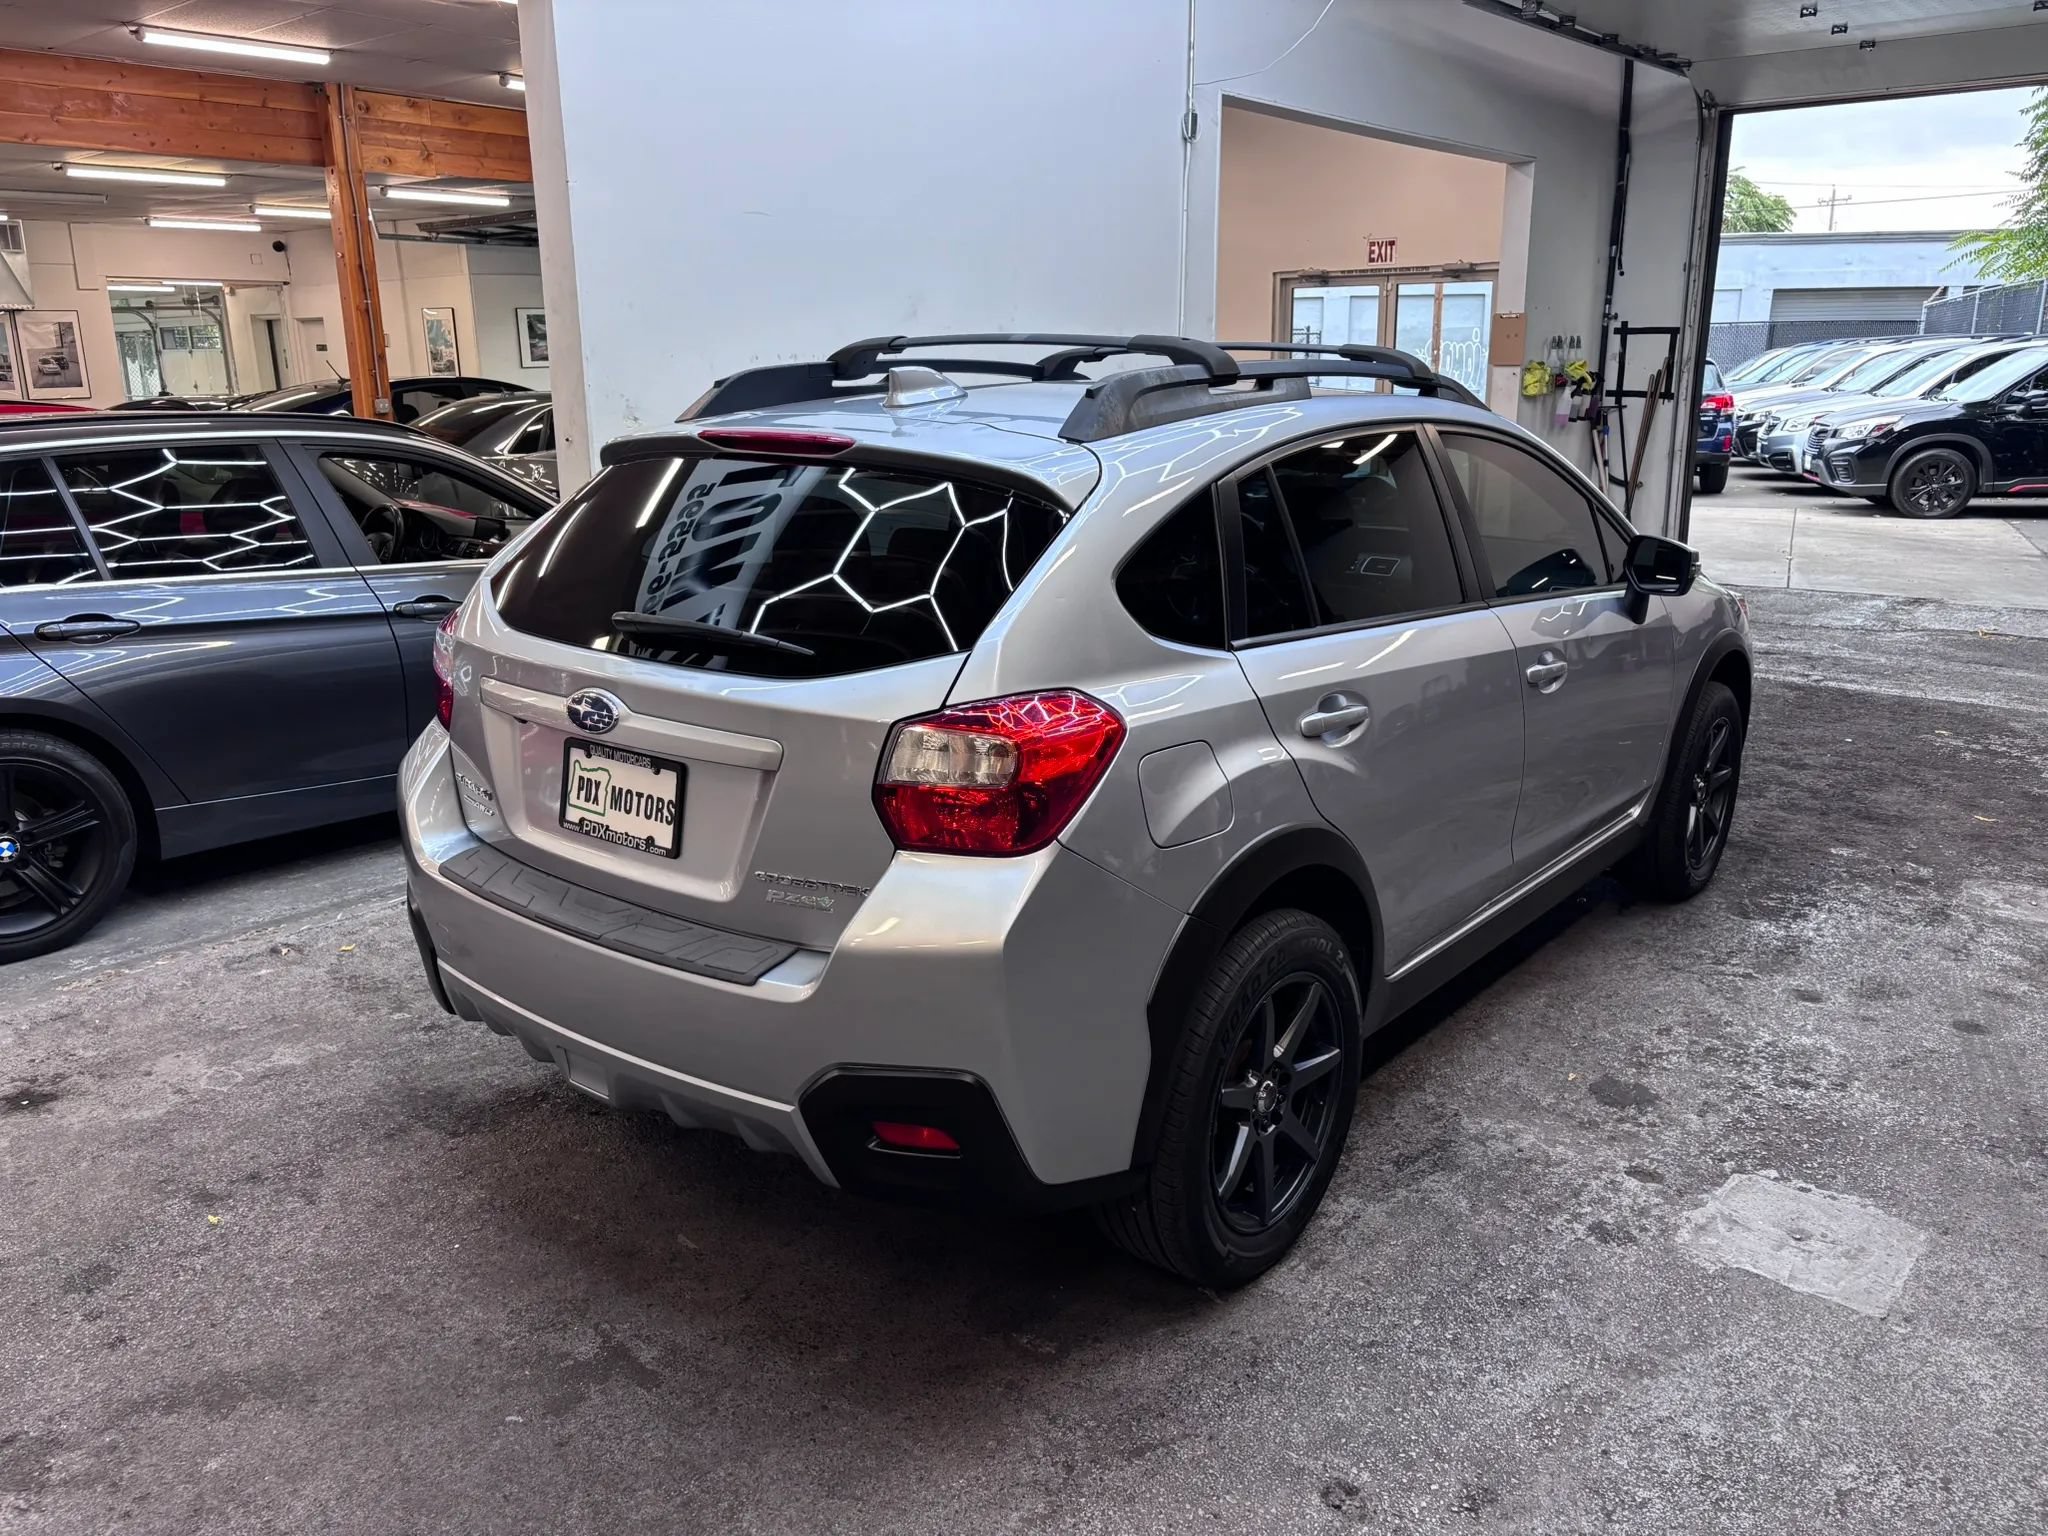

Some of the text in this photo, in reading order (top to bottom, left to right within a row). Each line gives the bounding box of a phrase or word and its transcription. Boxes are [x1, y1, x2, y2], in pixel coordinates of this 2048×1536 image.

[1368, 240, 1396, 263] EXIT
[590, 744, 652, 768] QUALITY MOTORCARS
[576, 775, 676, 826] PDX MOTORS
[563, 820, 667, 857] www.PDXmotors.com
[755, 870, 871, 897] CROSSTREK
